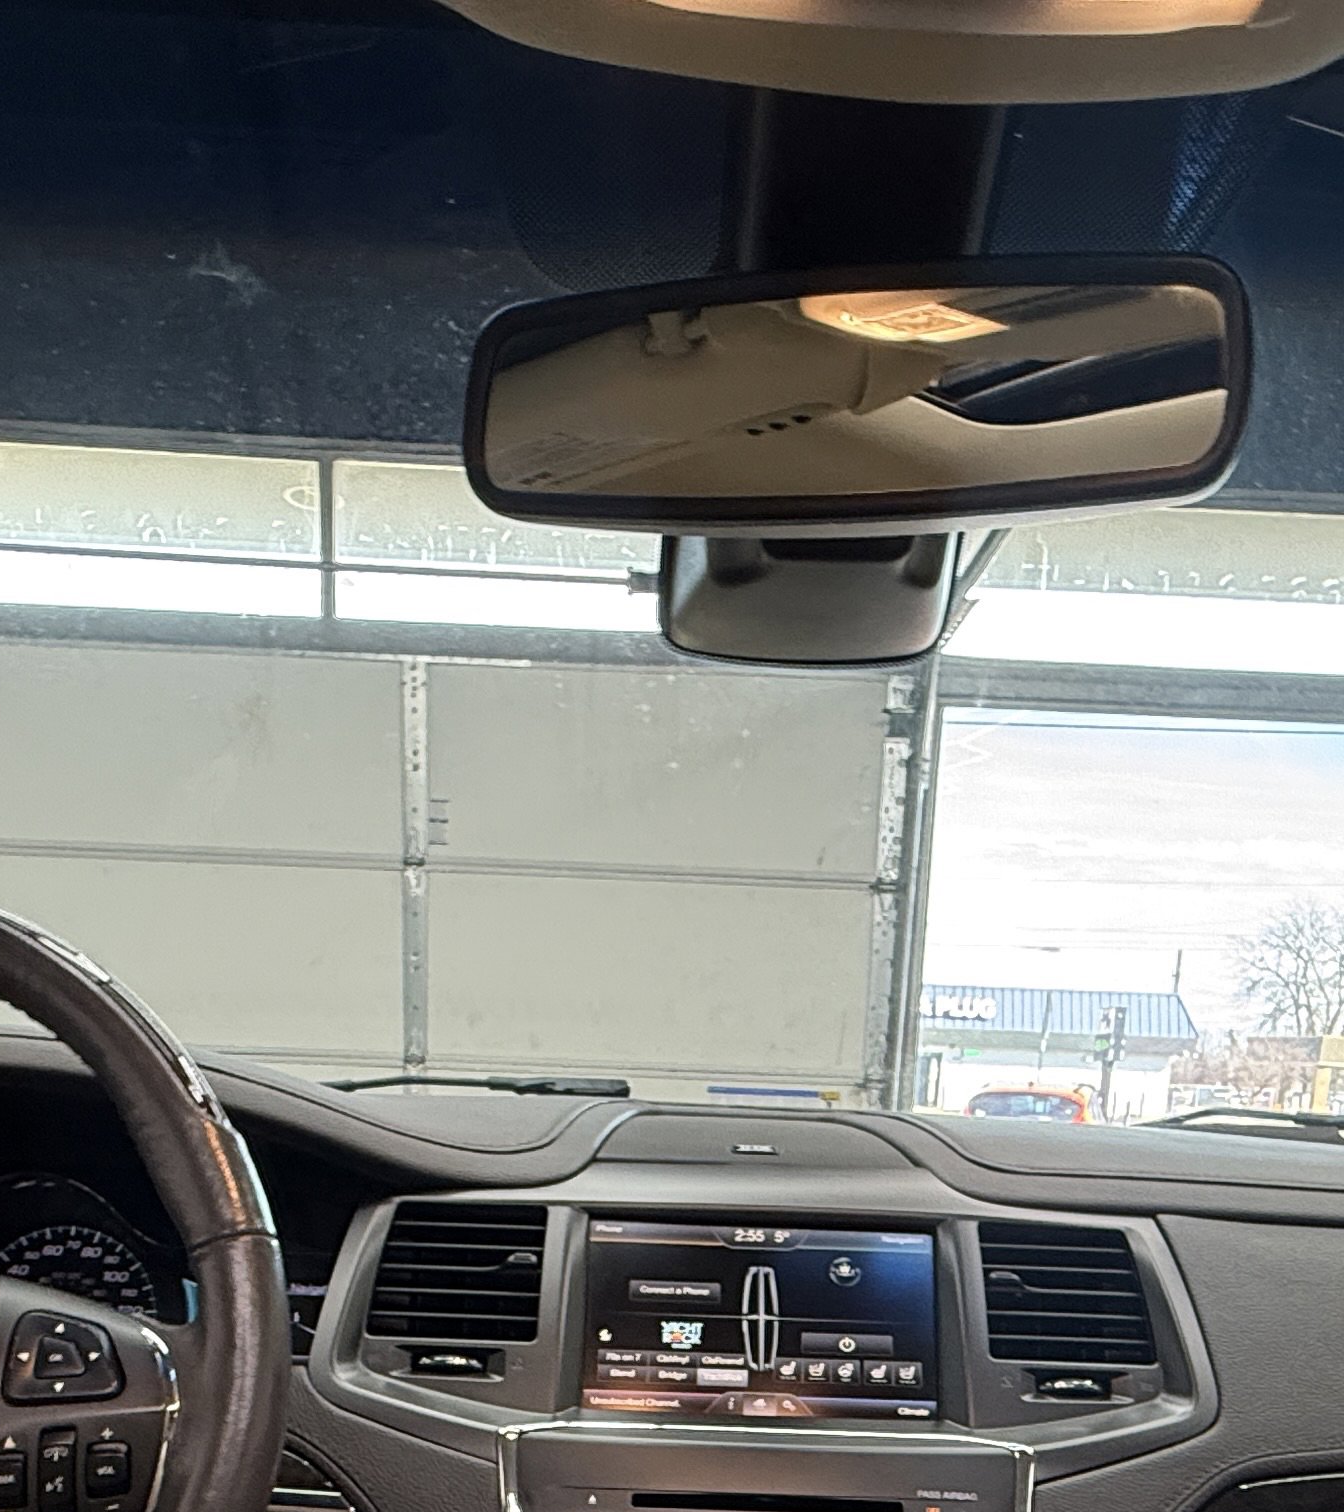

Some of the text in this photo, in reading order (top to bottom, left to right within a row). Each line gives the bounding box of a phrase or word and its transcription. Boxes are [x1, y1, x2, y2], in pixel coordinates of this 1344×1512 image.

[42, 1245, 64, 1256] 60
[7, 1264, 30, 1275] 40
[103, 1271, 129, 1282] 100
[917, 1490, 979, 1501] PASS AIRBAG
